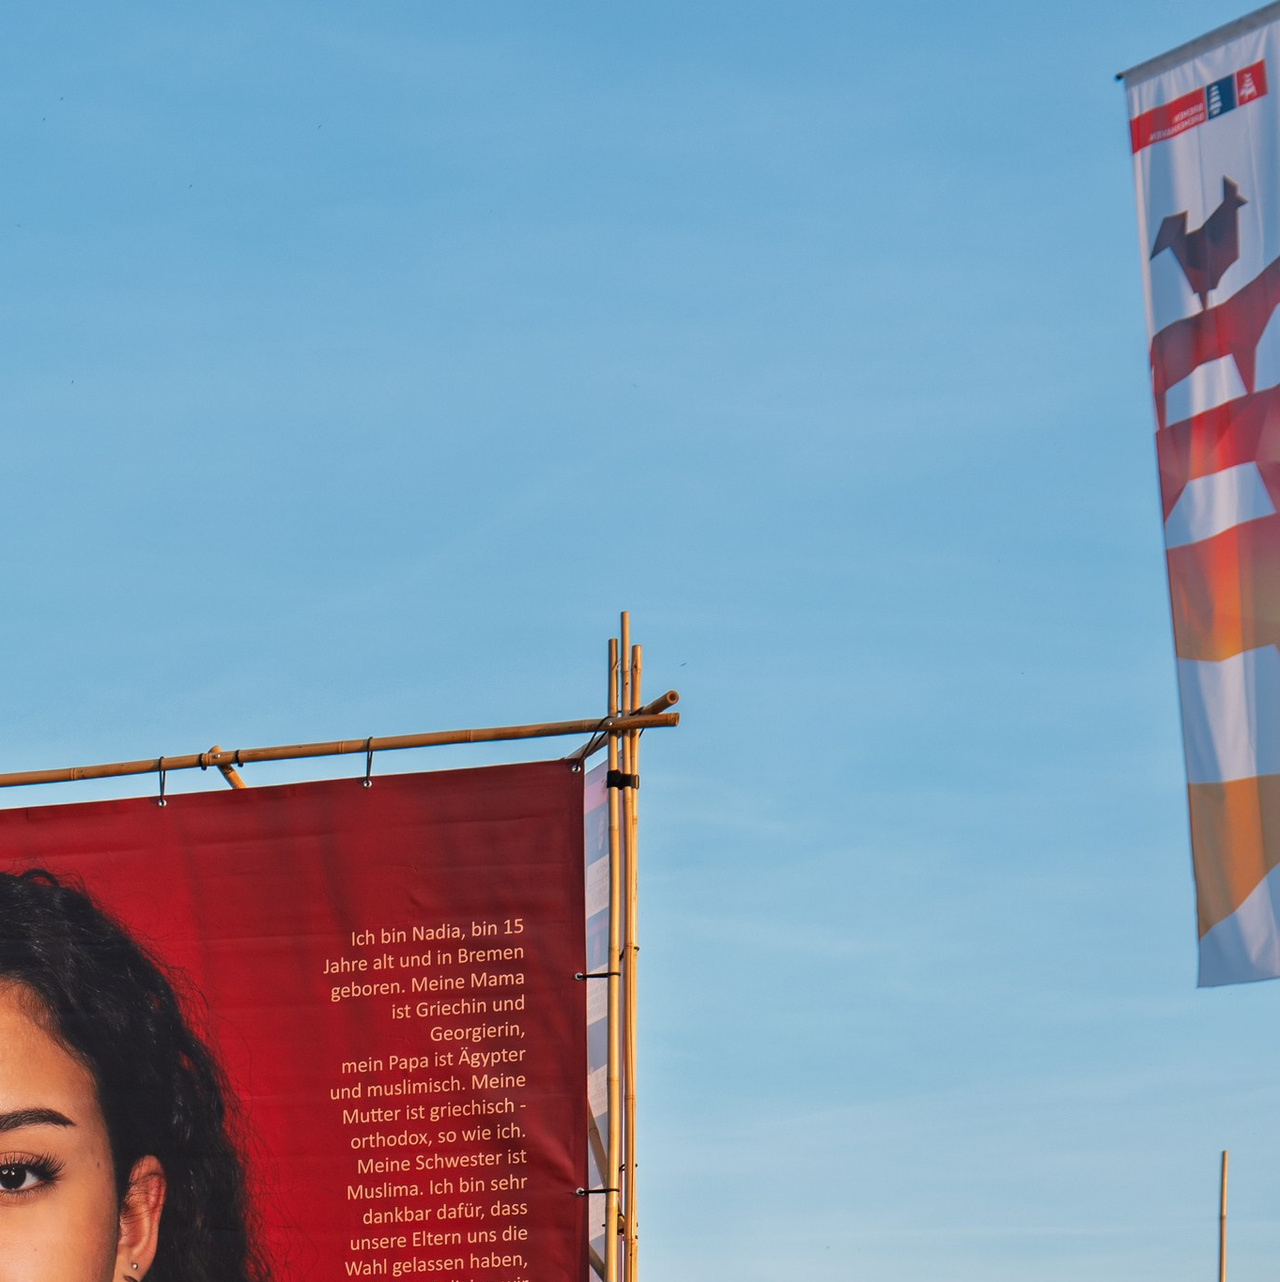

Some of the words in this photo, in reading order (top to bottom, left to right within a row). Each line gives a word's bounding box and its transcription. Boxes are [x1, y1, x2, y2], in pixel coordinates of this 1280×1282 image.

[351, 929, 375, 947] Ich
[381, 927, 407, 944] bin
[412, 923, 466, 942] Nadia,
[471, 920, 498, 937] bin
[503, 918, 524, 935] 15
[323, 956, 368, 975] Jahre
[373, 953, 395, 970] alt
[399, 949, 432, 968] und
[437, 949, 452, 965] in
[458, 947, 524, 964] Bremen
[330, 981, 406, 1003] geboren.
[411, 975, 465, 993] Meine
[470, 972, 525, 988] Mama
[392, 1004, 411, 1020] ist
[416, 998, 487, 1018] Griechin
[492, 994, 525, 1012] und
[430, 1021, 525, 1043] Georgierin,
[342, 1059, 383, 1074] mein
[389, 1055, 429, 1073] Papa
[434, 1052, 454, 1067] ist
[458, 1046, 527, 1068] Ägypter
[330, 1082, 362, 1101] und
[367, 1075, 466, 1098] muslimisch.
[471, 1072, 526, 1090] Meine
[342, 1107, 401, 1125] Mutter
[406, 1104, 425, 1120] ist
[429, 1097, 515, 1122] griechisch
[350, 1129, 433, 1150] orthodox,
[437, 1131, 457, 1144] so
[461, 1125, 492, 1142] wie
[496, 1122, 526, 1139] ich.
[357, 1157, 411, 1175] Meine
[415, 1152, 503, 1171] Schwester
[508, 1149, 527, 1165] ist
[347, 1182, 424, 1200] Muslima.
[429, 1178, 454, 1195] Ich
[459, 1177, 485, 1193] bin
[490, 1173, 528, 1191] sehr
[362, 1206, 432, 1225] dankbar
[436, 1202, 485, 1220] dafür,
[490, 1200, 528, 1217] dass
[350, 1236, 407, 1251] unsere
[412, 1230, 462, 1247] Eltern
[467, 1230, 497, 1244] uns
[501, 1225, 528, 1242] die
[344, 1258, 387, 1276] Wahl
[392, 1256, 464, 1277] gelassen
[470, 1251, 528, 1269] haben,
